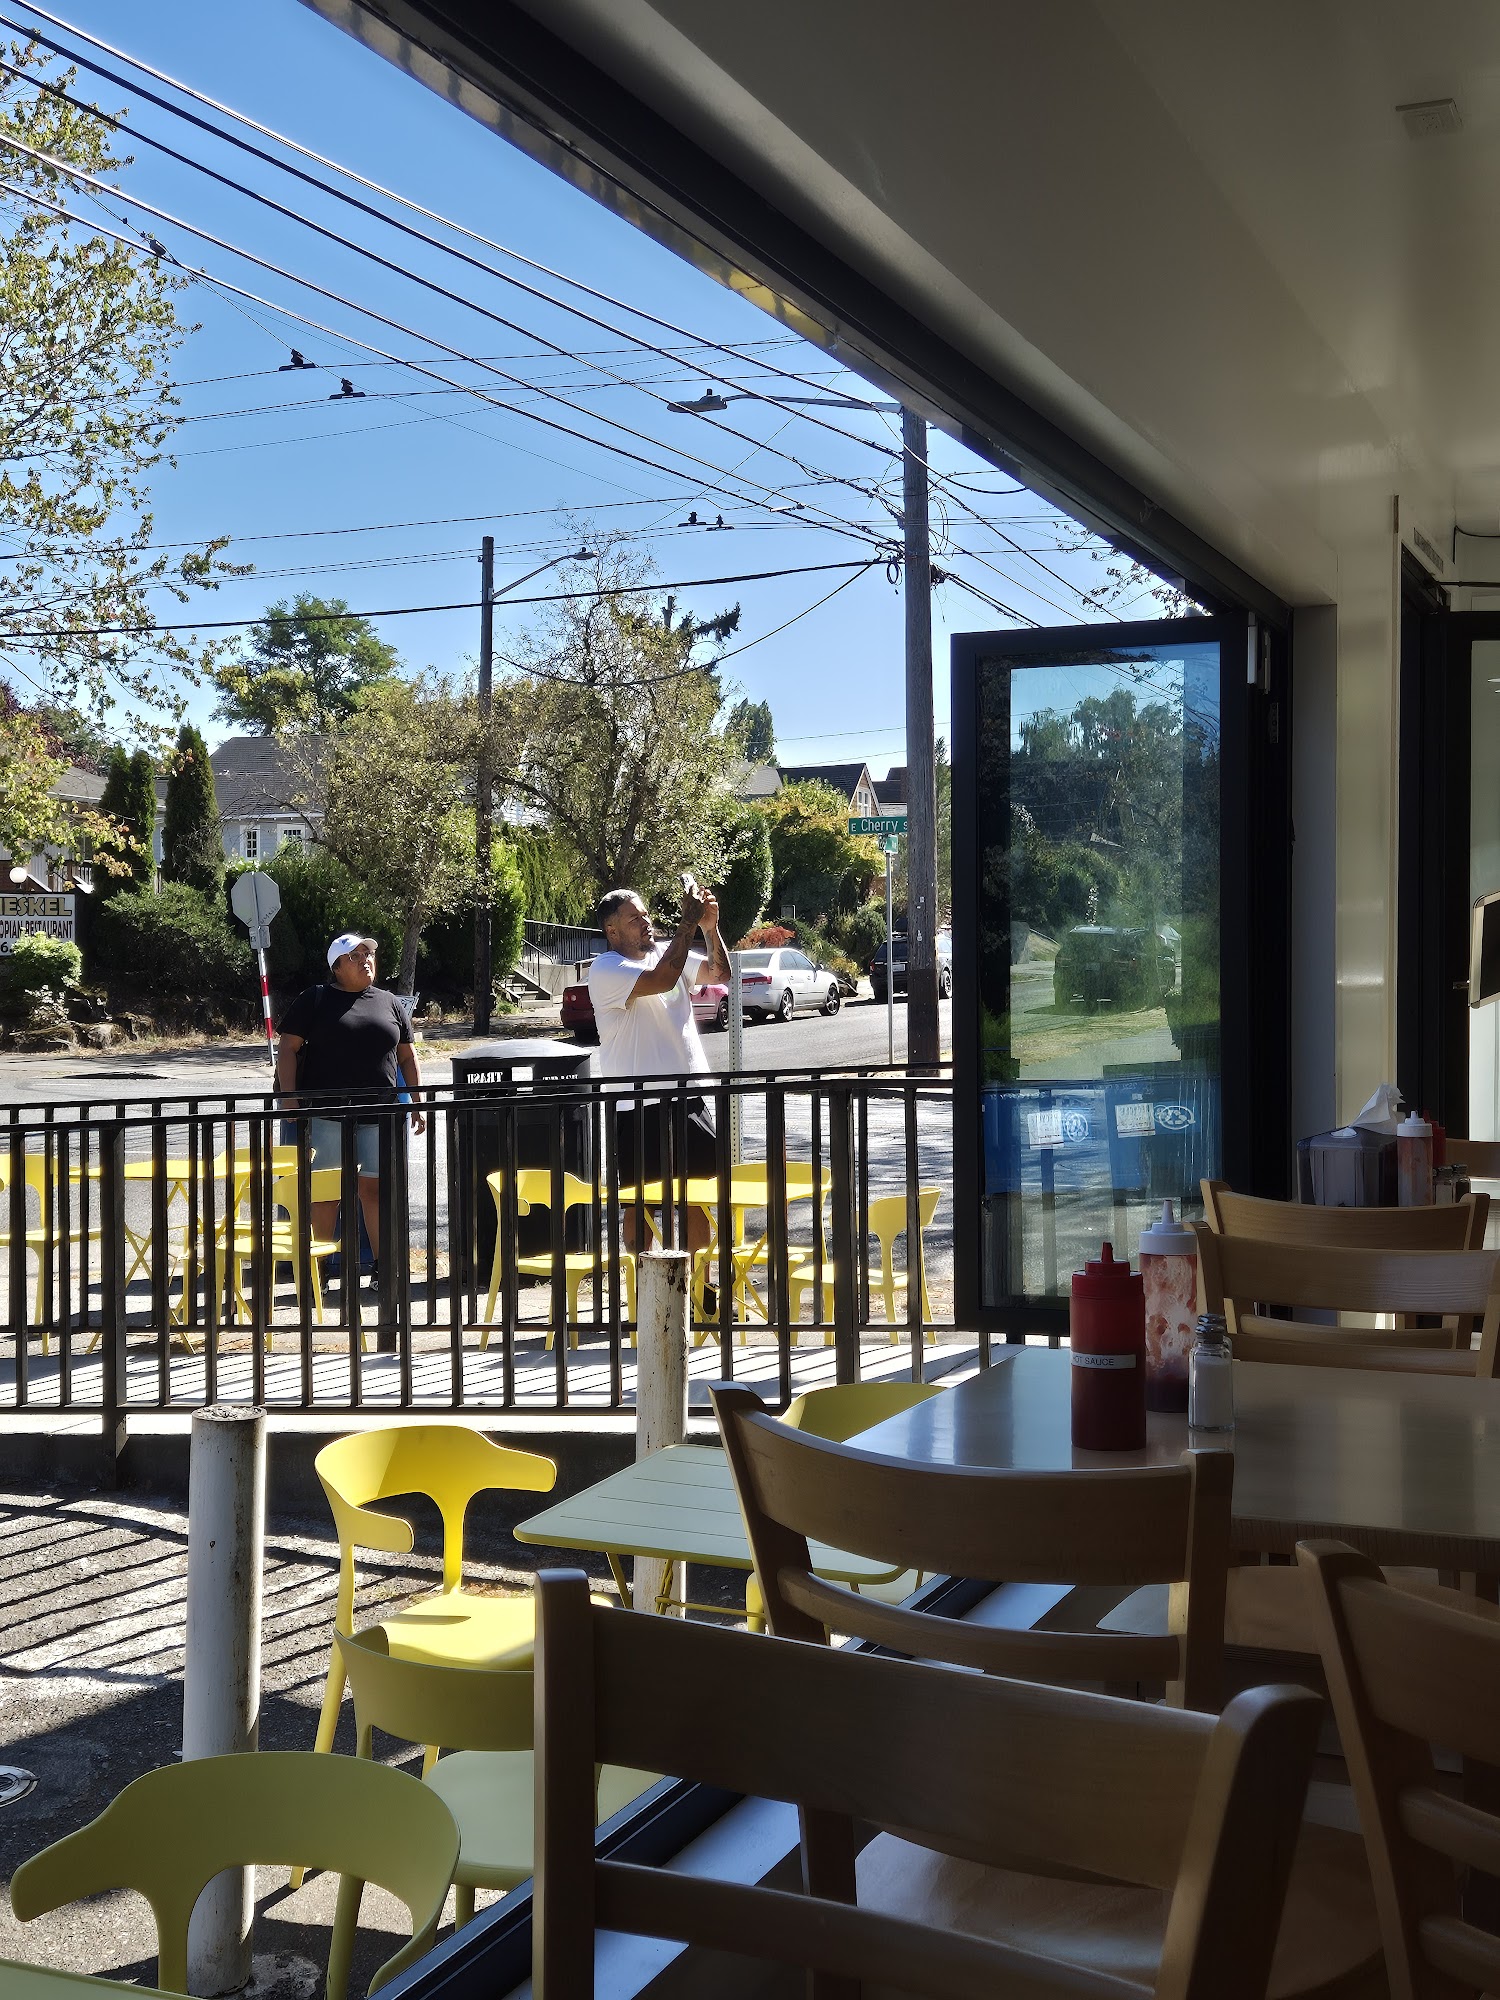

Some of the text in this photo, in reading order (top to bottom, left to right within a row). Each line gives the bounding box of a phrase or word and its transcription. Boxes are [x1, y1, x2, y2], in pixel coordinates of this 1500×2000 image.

[851, 823, 857, 832] E
[861, 818, 898, 832] Cherry
[0, 896, 73, 917] ESKEL
[1084, 1356, 1115, 1366] SAUCE
